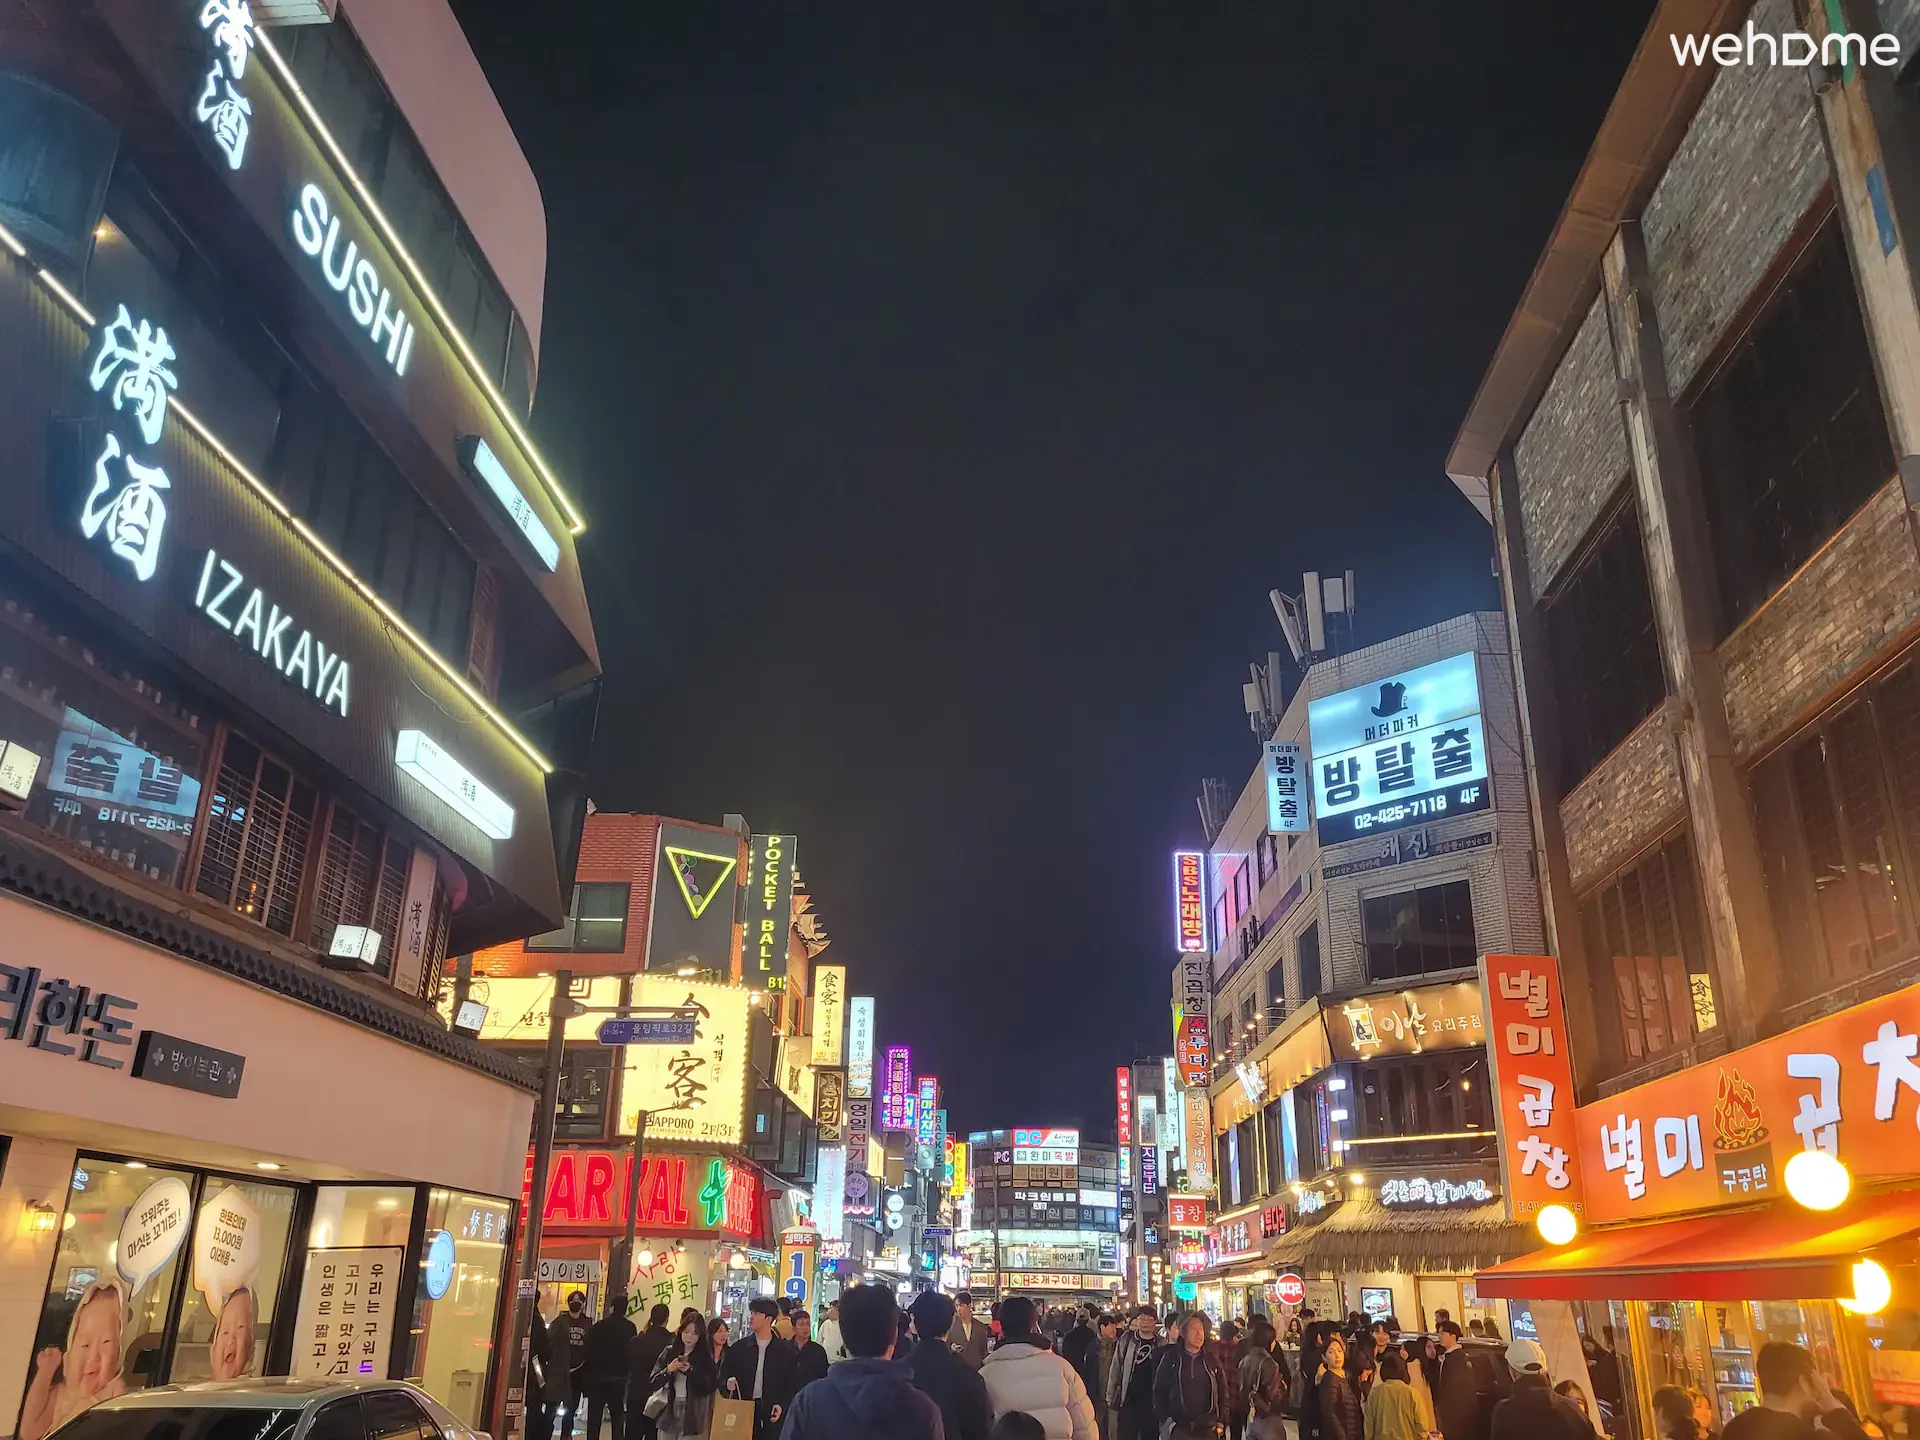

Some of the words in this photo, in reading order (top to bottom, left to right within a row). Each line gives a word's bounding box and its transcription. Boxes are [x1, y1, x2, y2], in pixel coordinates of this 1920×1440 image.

[291, 183, 415, 377] SUSHI
[195, 549, 350, 717] IZAKAYA
[1365, 714, 1418, 741] 머더파커
[1276, 756, 1298, 818] 방탈출
[1323, 727, 1472, 807] 방탈출
[1354, 795, 1447, 830] 02-425-7118
[1460, 787, 1480, 804] 4F
[1381, 827, 1429, 864] 해진
[763, 836, 781, 911] POCKET
[1182, 886, 1202, 936] 노래방
[759, 920, 774, 970] BALL
[768, 977, 783, 988] B1
[521, 1012, 551, 1026] 선술
[632, 1023, 692, 1034] 올림픽로32길
[1432, 1015, 1482, 1033] 요리주점
[1498, 969, 1555, 1055] 별미
[1188, 1036, 1209, 1085] 투다리
[701, 1123, 735, 1138] 2F/3F
[1015, 1131, 1042, 1144] PC
[1517, 1074, 1571, 1190] 곱창
[994, 1151, 1010, 1163] PC
[1030, 1151, 1074, 1161] 완미족발
[1142, 1147, 1157, 1194] 지금부터
[1601, 1113, 1703, 1200] 별미
[1015, 1192, 1076, 1202] 파크원
[1722, 1163, 1768, 1193] 구공탄
[212, 1226, 243, 1250] 13,000원
[785, 1234, 813, 1245] 생맥주
[631, 1245, 684, 1286] 사랑
[1030, 1274, 1081, 1286] 조개구이집
[318, 1265, 336, 1315] 인생은
[342, 1264, 360, 1314] 고기는
[366, 1263, 384, 1313] 우리는
[652, 1273, 699, 1305] 평화
[335, 1323, 354, 1374] 맛있고
